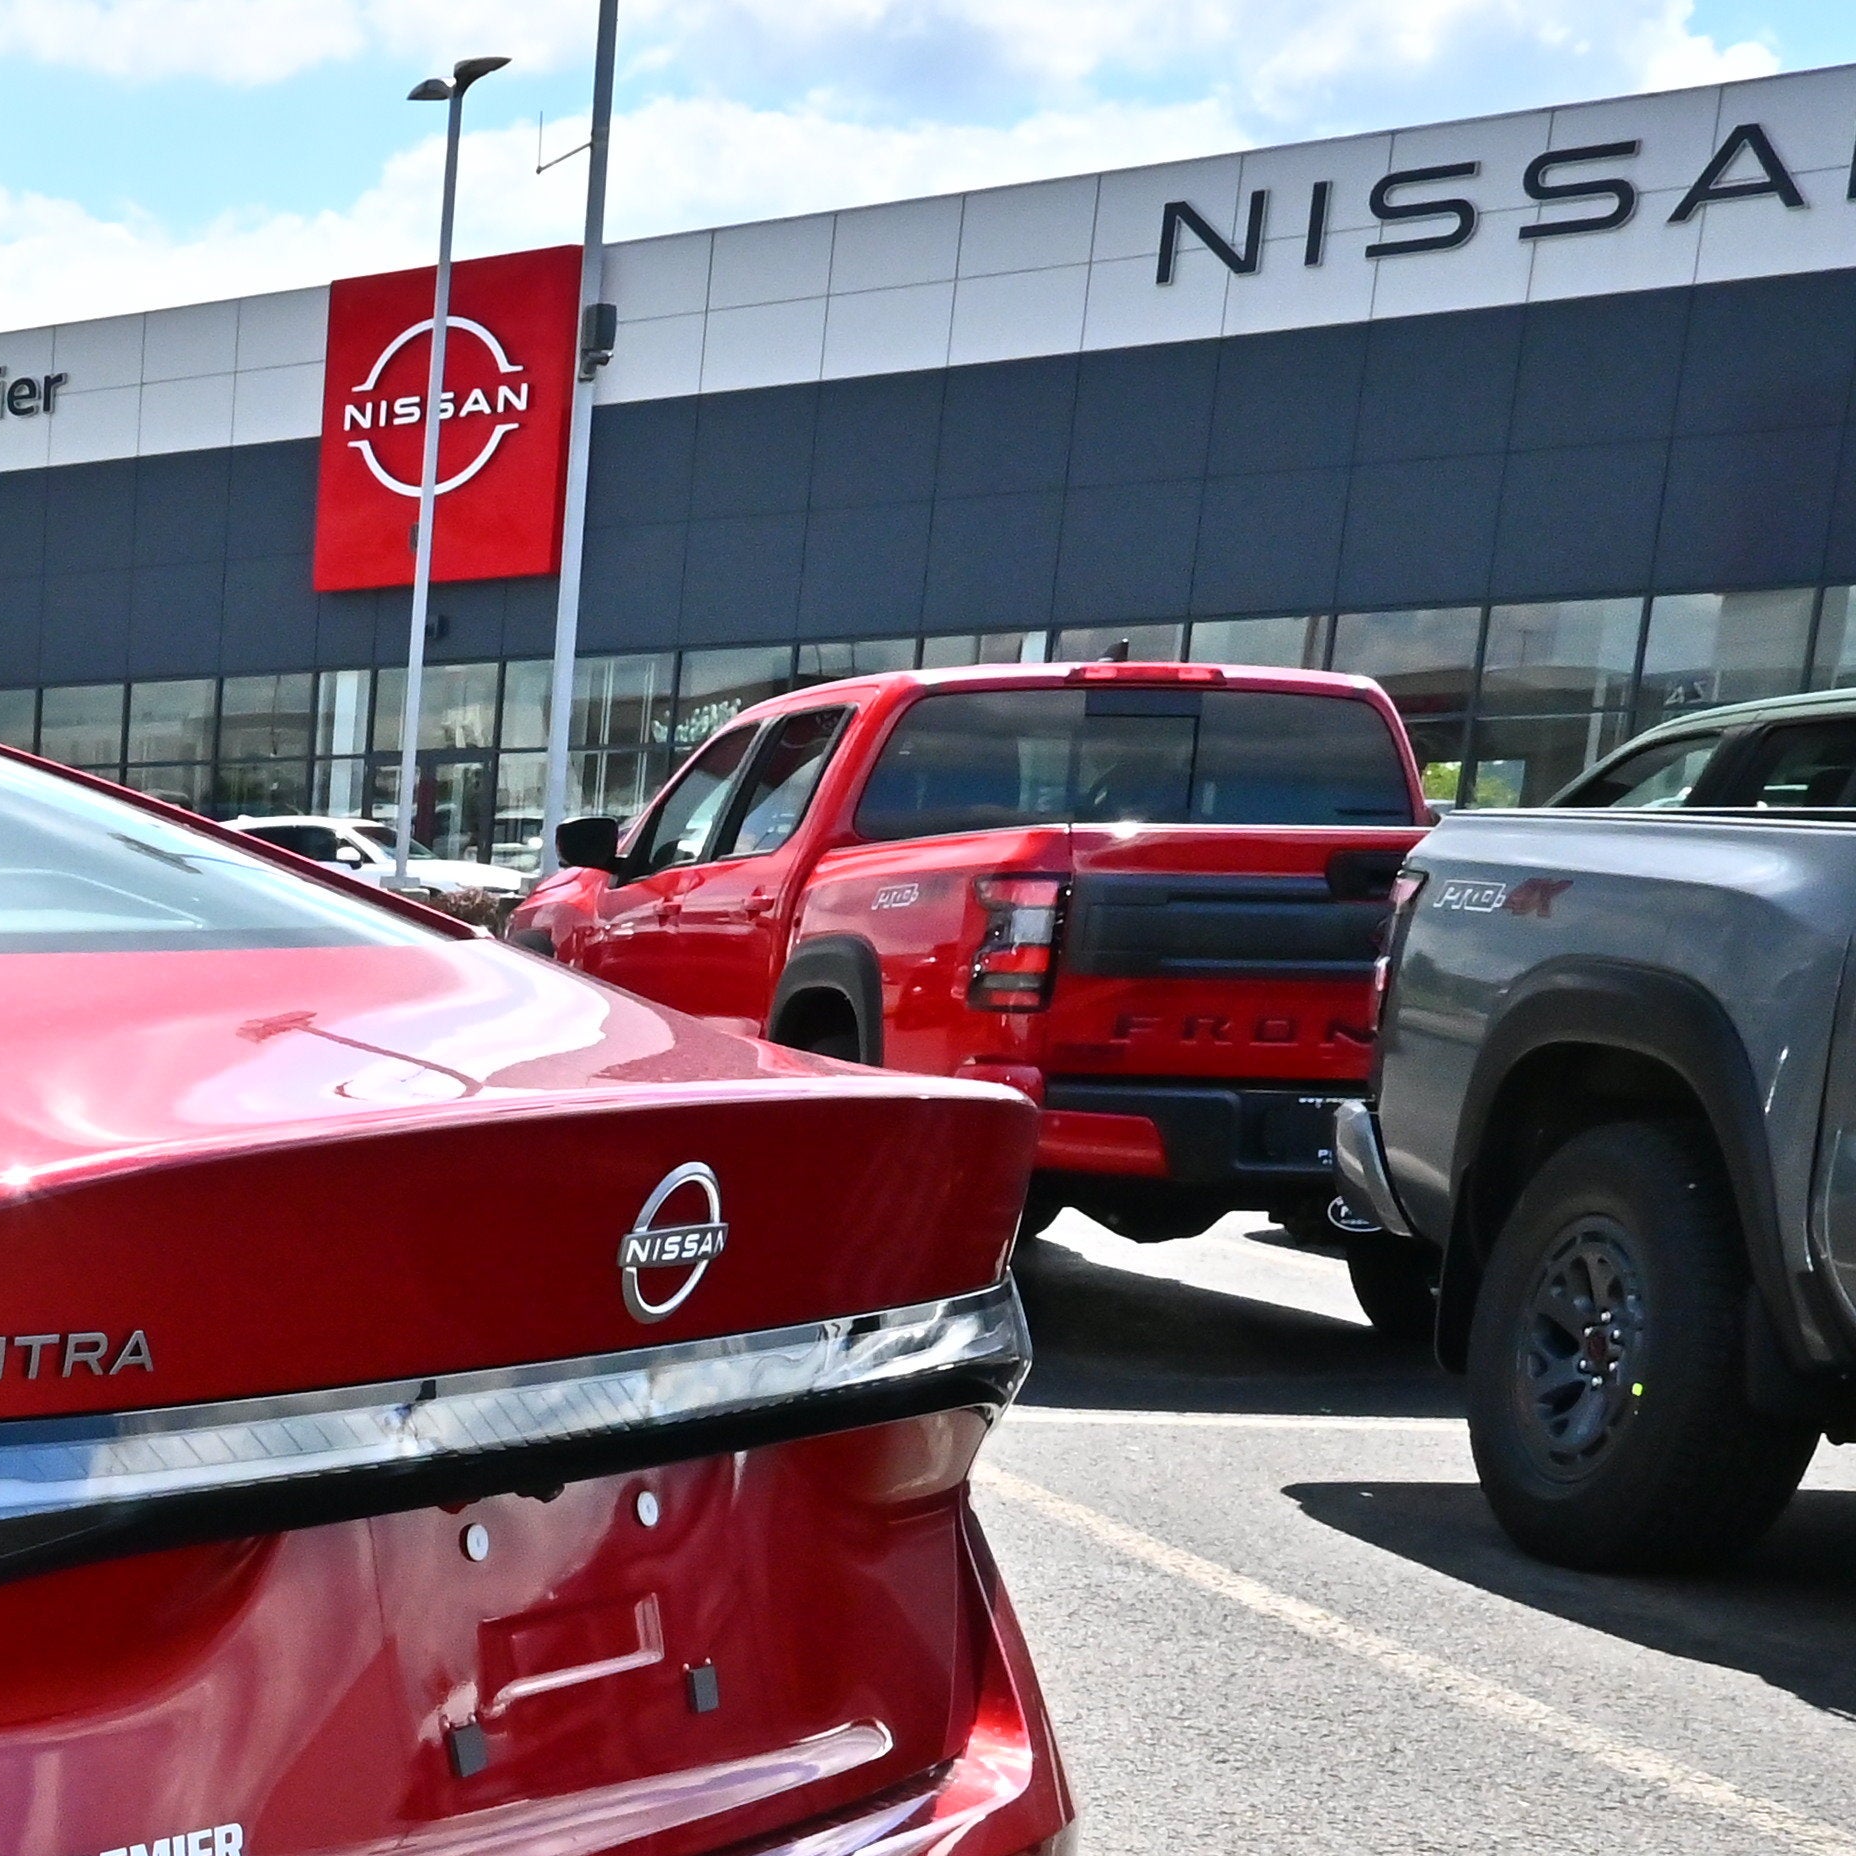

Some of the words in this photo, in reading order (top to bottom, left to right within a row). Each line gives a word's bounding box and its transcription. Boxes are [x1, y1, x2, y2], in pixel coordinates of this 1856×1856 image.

[1155, 123, 1856, 286] NISSA
[343, 382, 528, 431] NISSAN
[626, 1229, 725, 1264] NISSAN
